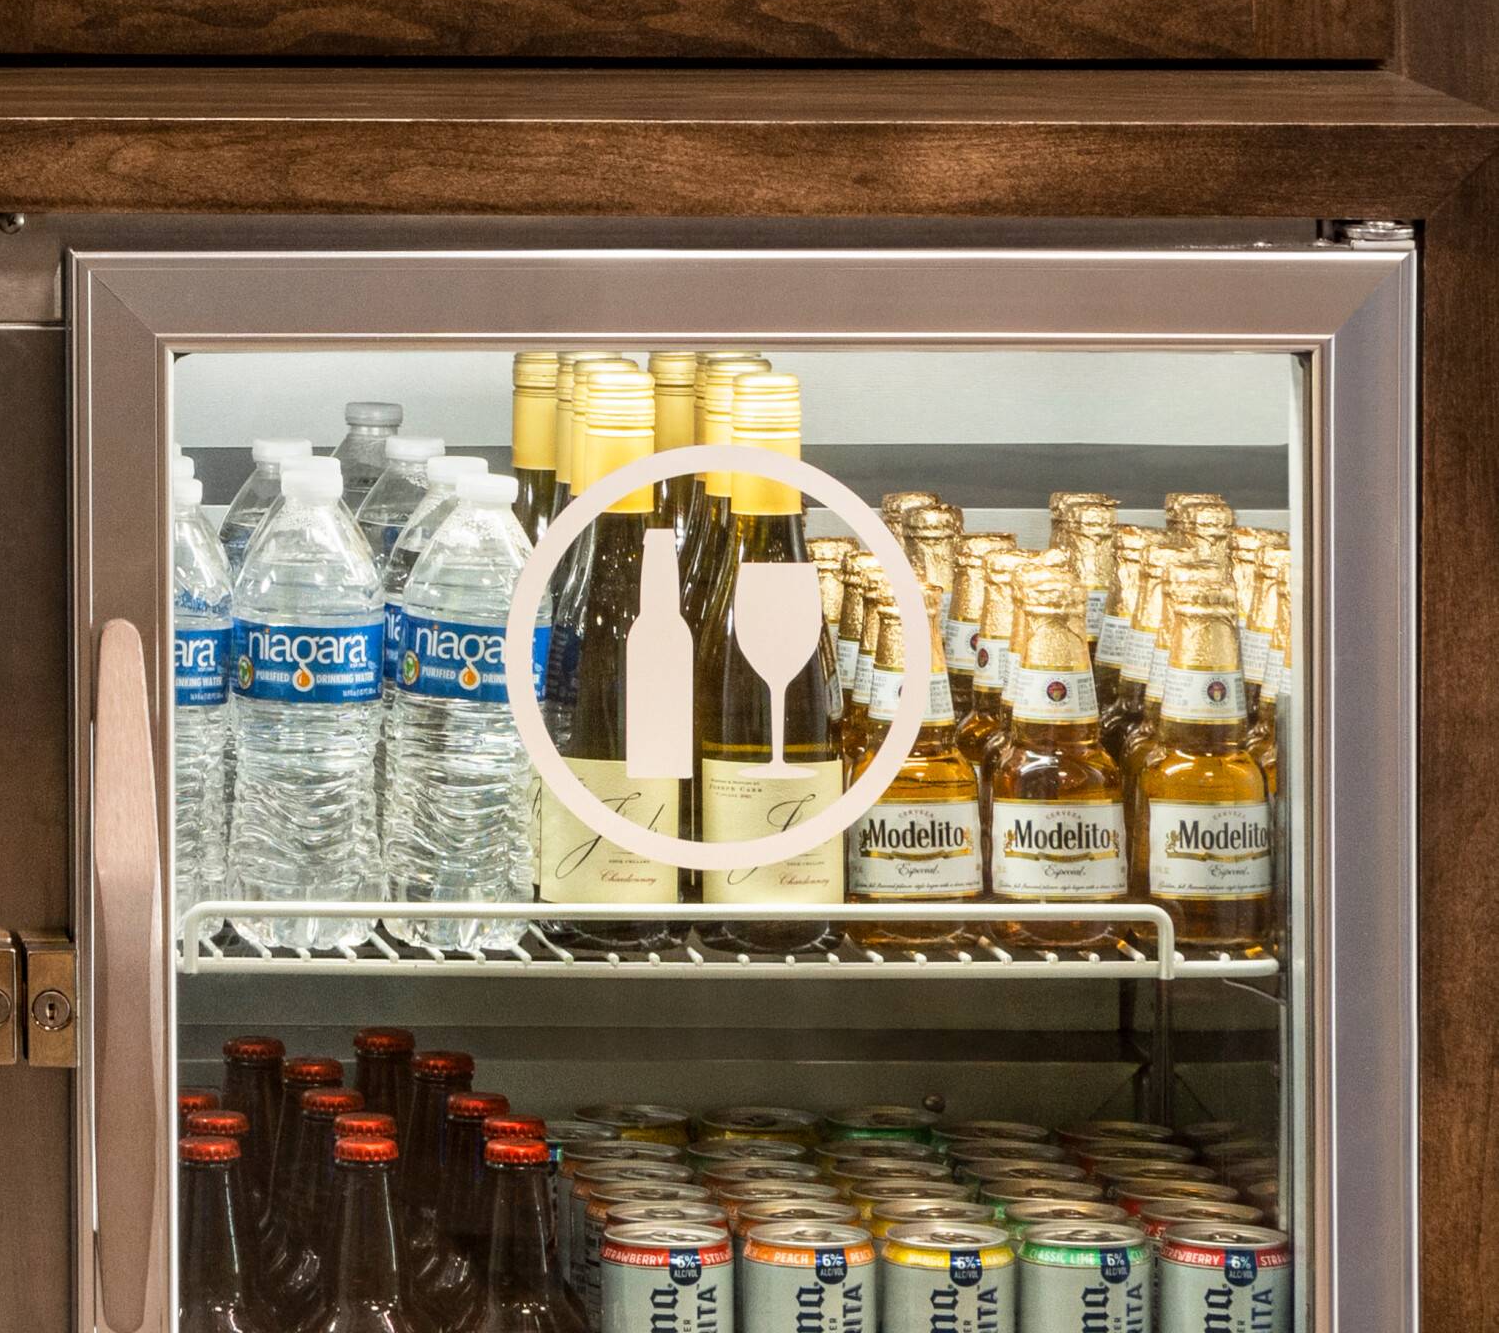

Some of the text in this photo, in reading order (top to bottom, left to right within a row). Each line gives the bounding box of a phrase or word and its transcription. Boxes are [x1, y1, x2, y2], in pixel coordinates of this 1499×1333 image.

[249, 628, 368, 669] niagara
[255, 670, 374, 685] PURIFIED DRINKING WATER
[421, 666, 456, 679] PURIFIED
[869, 820, 964, 849] Modelito
[1015, 819, 1111, 850] Modelito
[603, 1249, 664, 1265] STRAWBERRY
[773, 1252, 808, 1265] PEACH
[1029, 1248, 1095, 1265] CLASSIC LIME
[1160, 1246, 1220, 1266] STRAWBERRY
